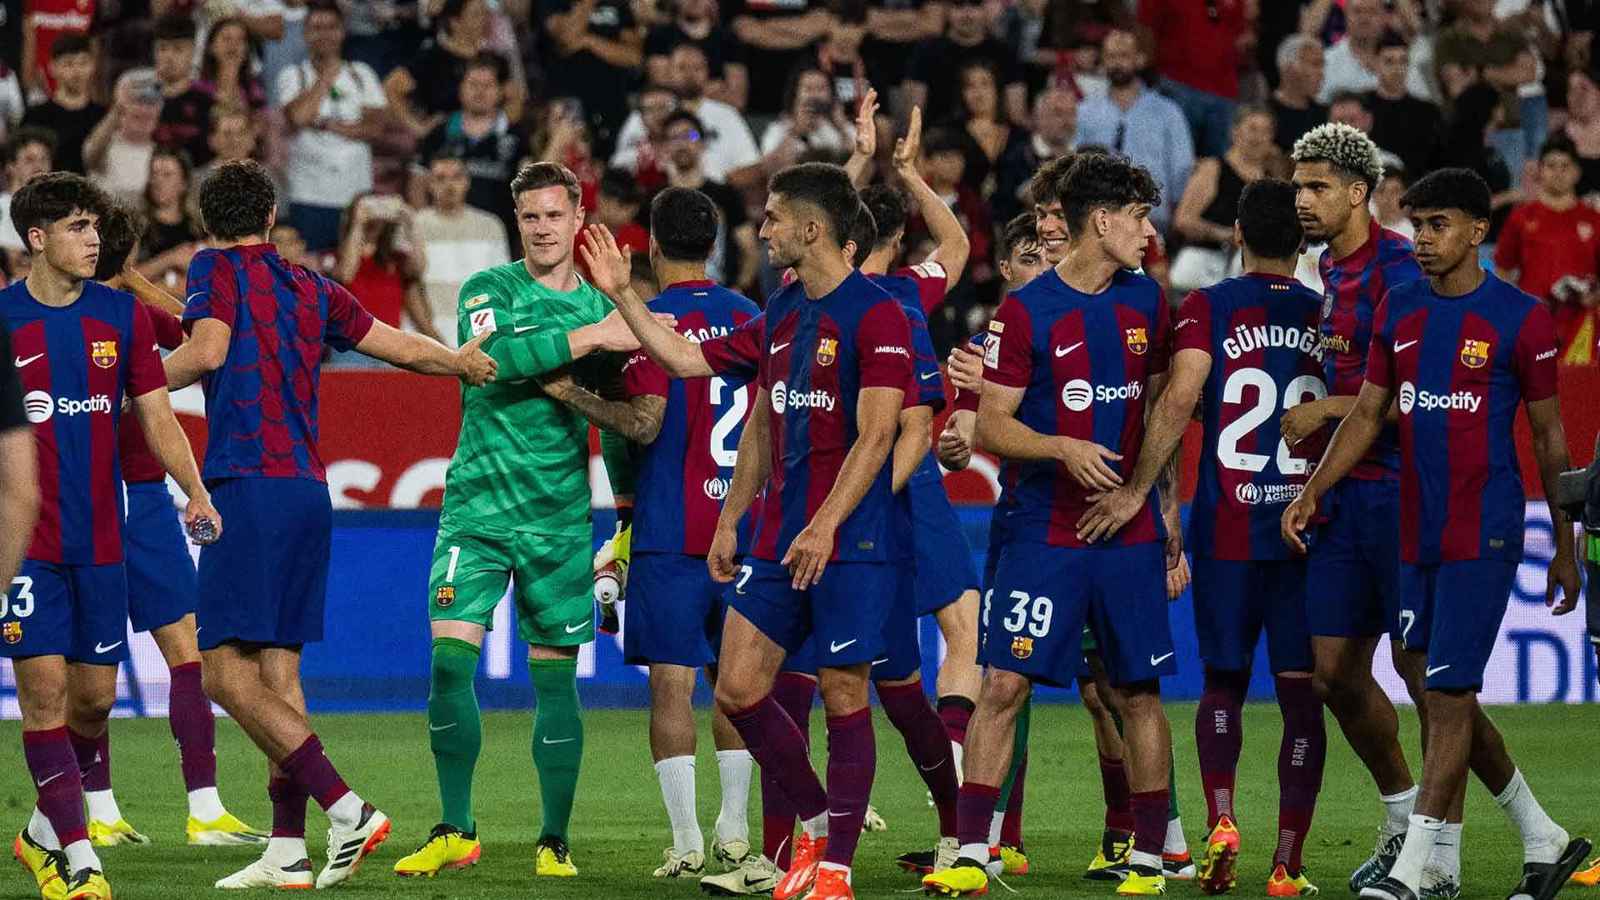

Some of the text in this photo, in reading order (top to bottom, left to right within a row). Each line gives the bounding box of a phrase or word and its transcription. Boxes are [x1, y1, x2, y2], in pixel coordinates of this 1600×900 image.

[788, 389, 835, 412] Spotify
[1096, 380, 1143, 403] Spotify
[1418, 390, 1482, 415] Spotify
[57, 394, 112, 416] Spotify
[1217, 367, 1329, 475] 22
[446, 546, 461, 583] 1
[1003, 590, 1053, 638] 39
